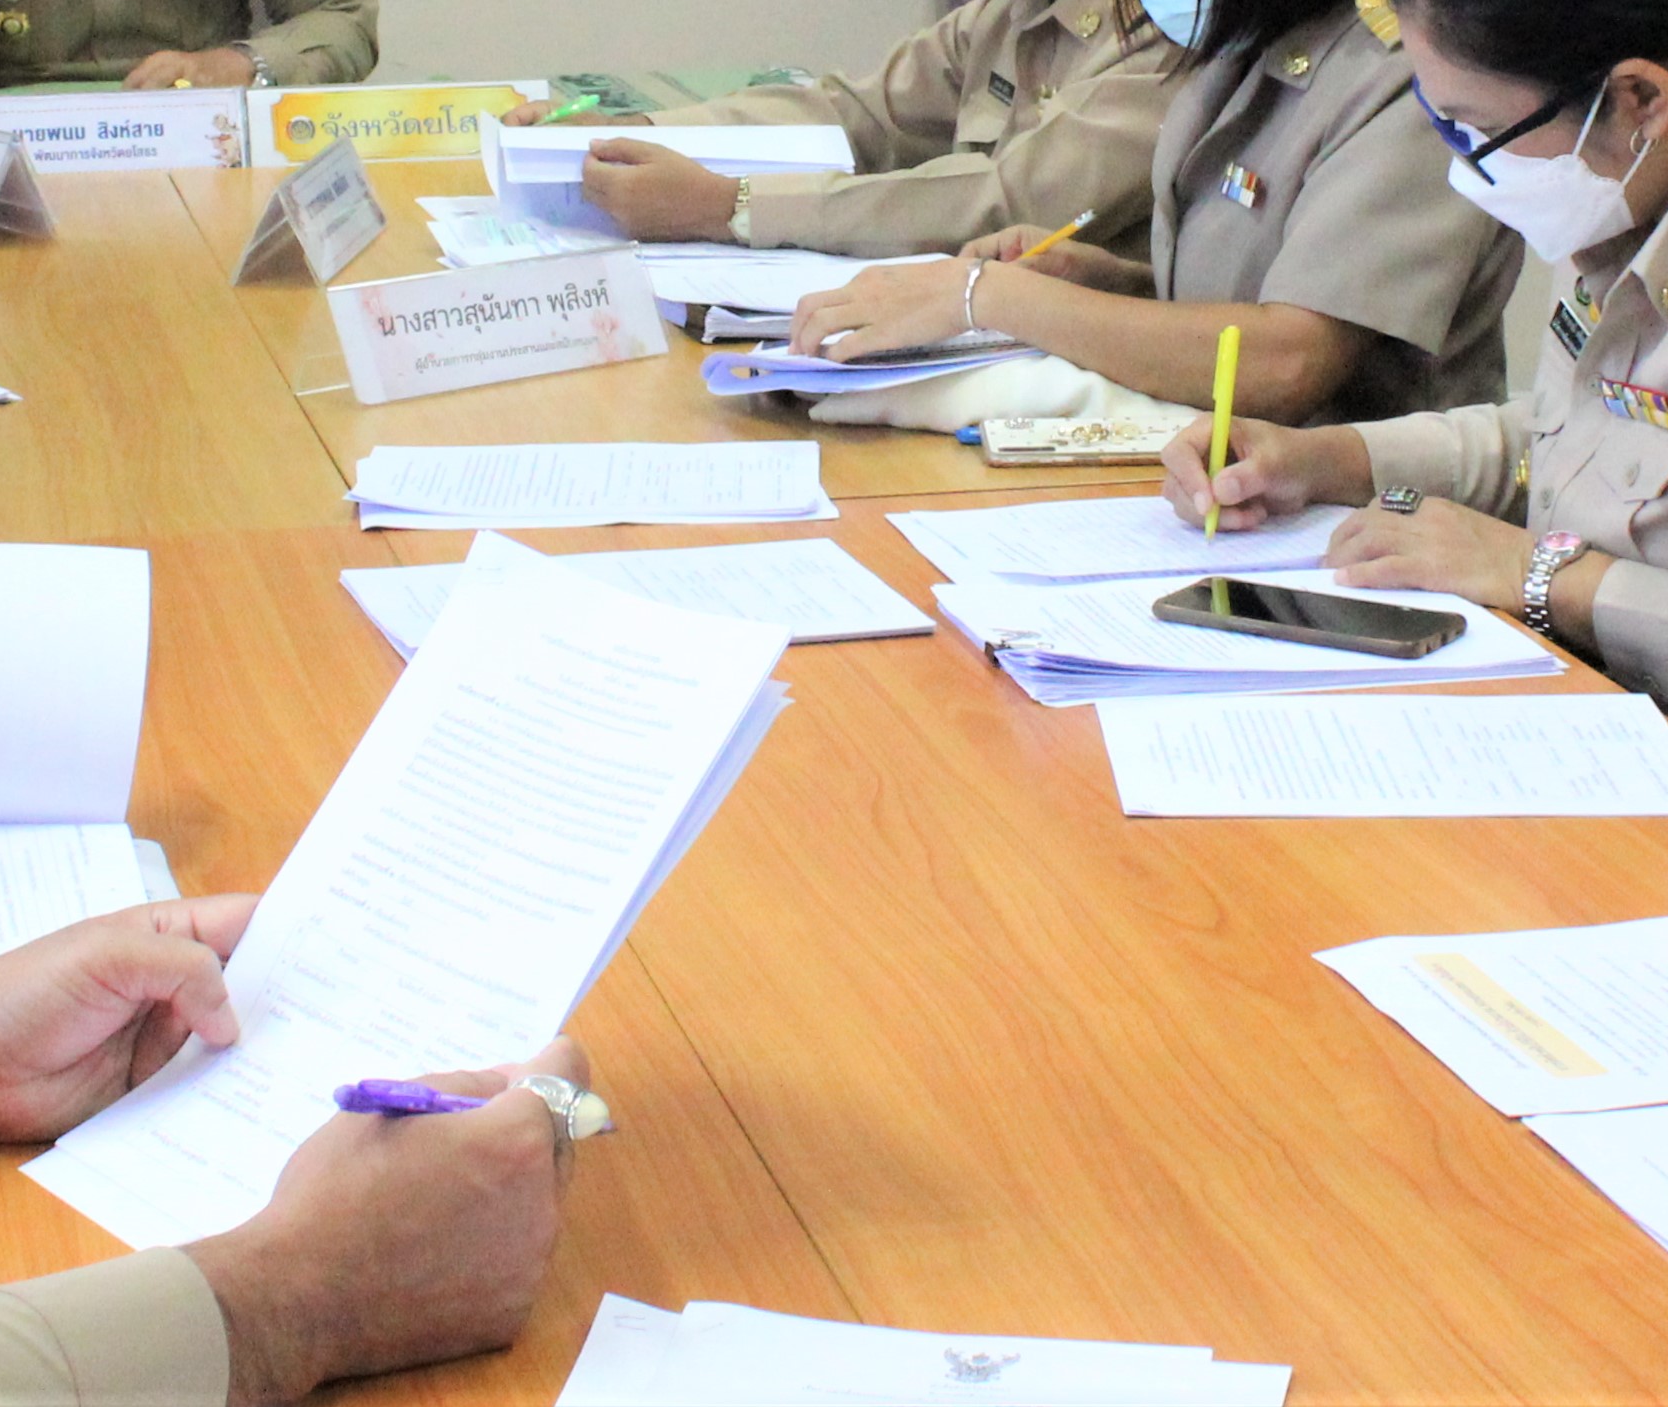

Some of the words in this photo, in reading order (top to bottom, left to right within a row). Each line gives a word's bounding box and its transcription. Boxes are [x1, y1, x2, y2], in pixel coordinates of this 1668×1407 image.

[97, 119, 165, 139] สิงห์สาย
[321, 104, 480, 139] จังหวัดยโส
[378, 293, 541, 338] นางสาวสุนันทา
[546, 279, 611, 323] พุสิงห์
